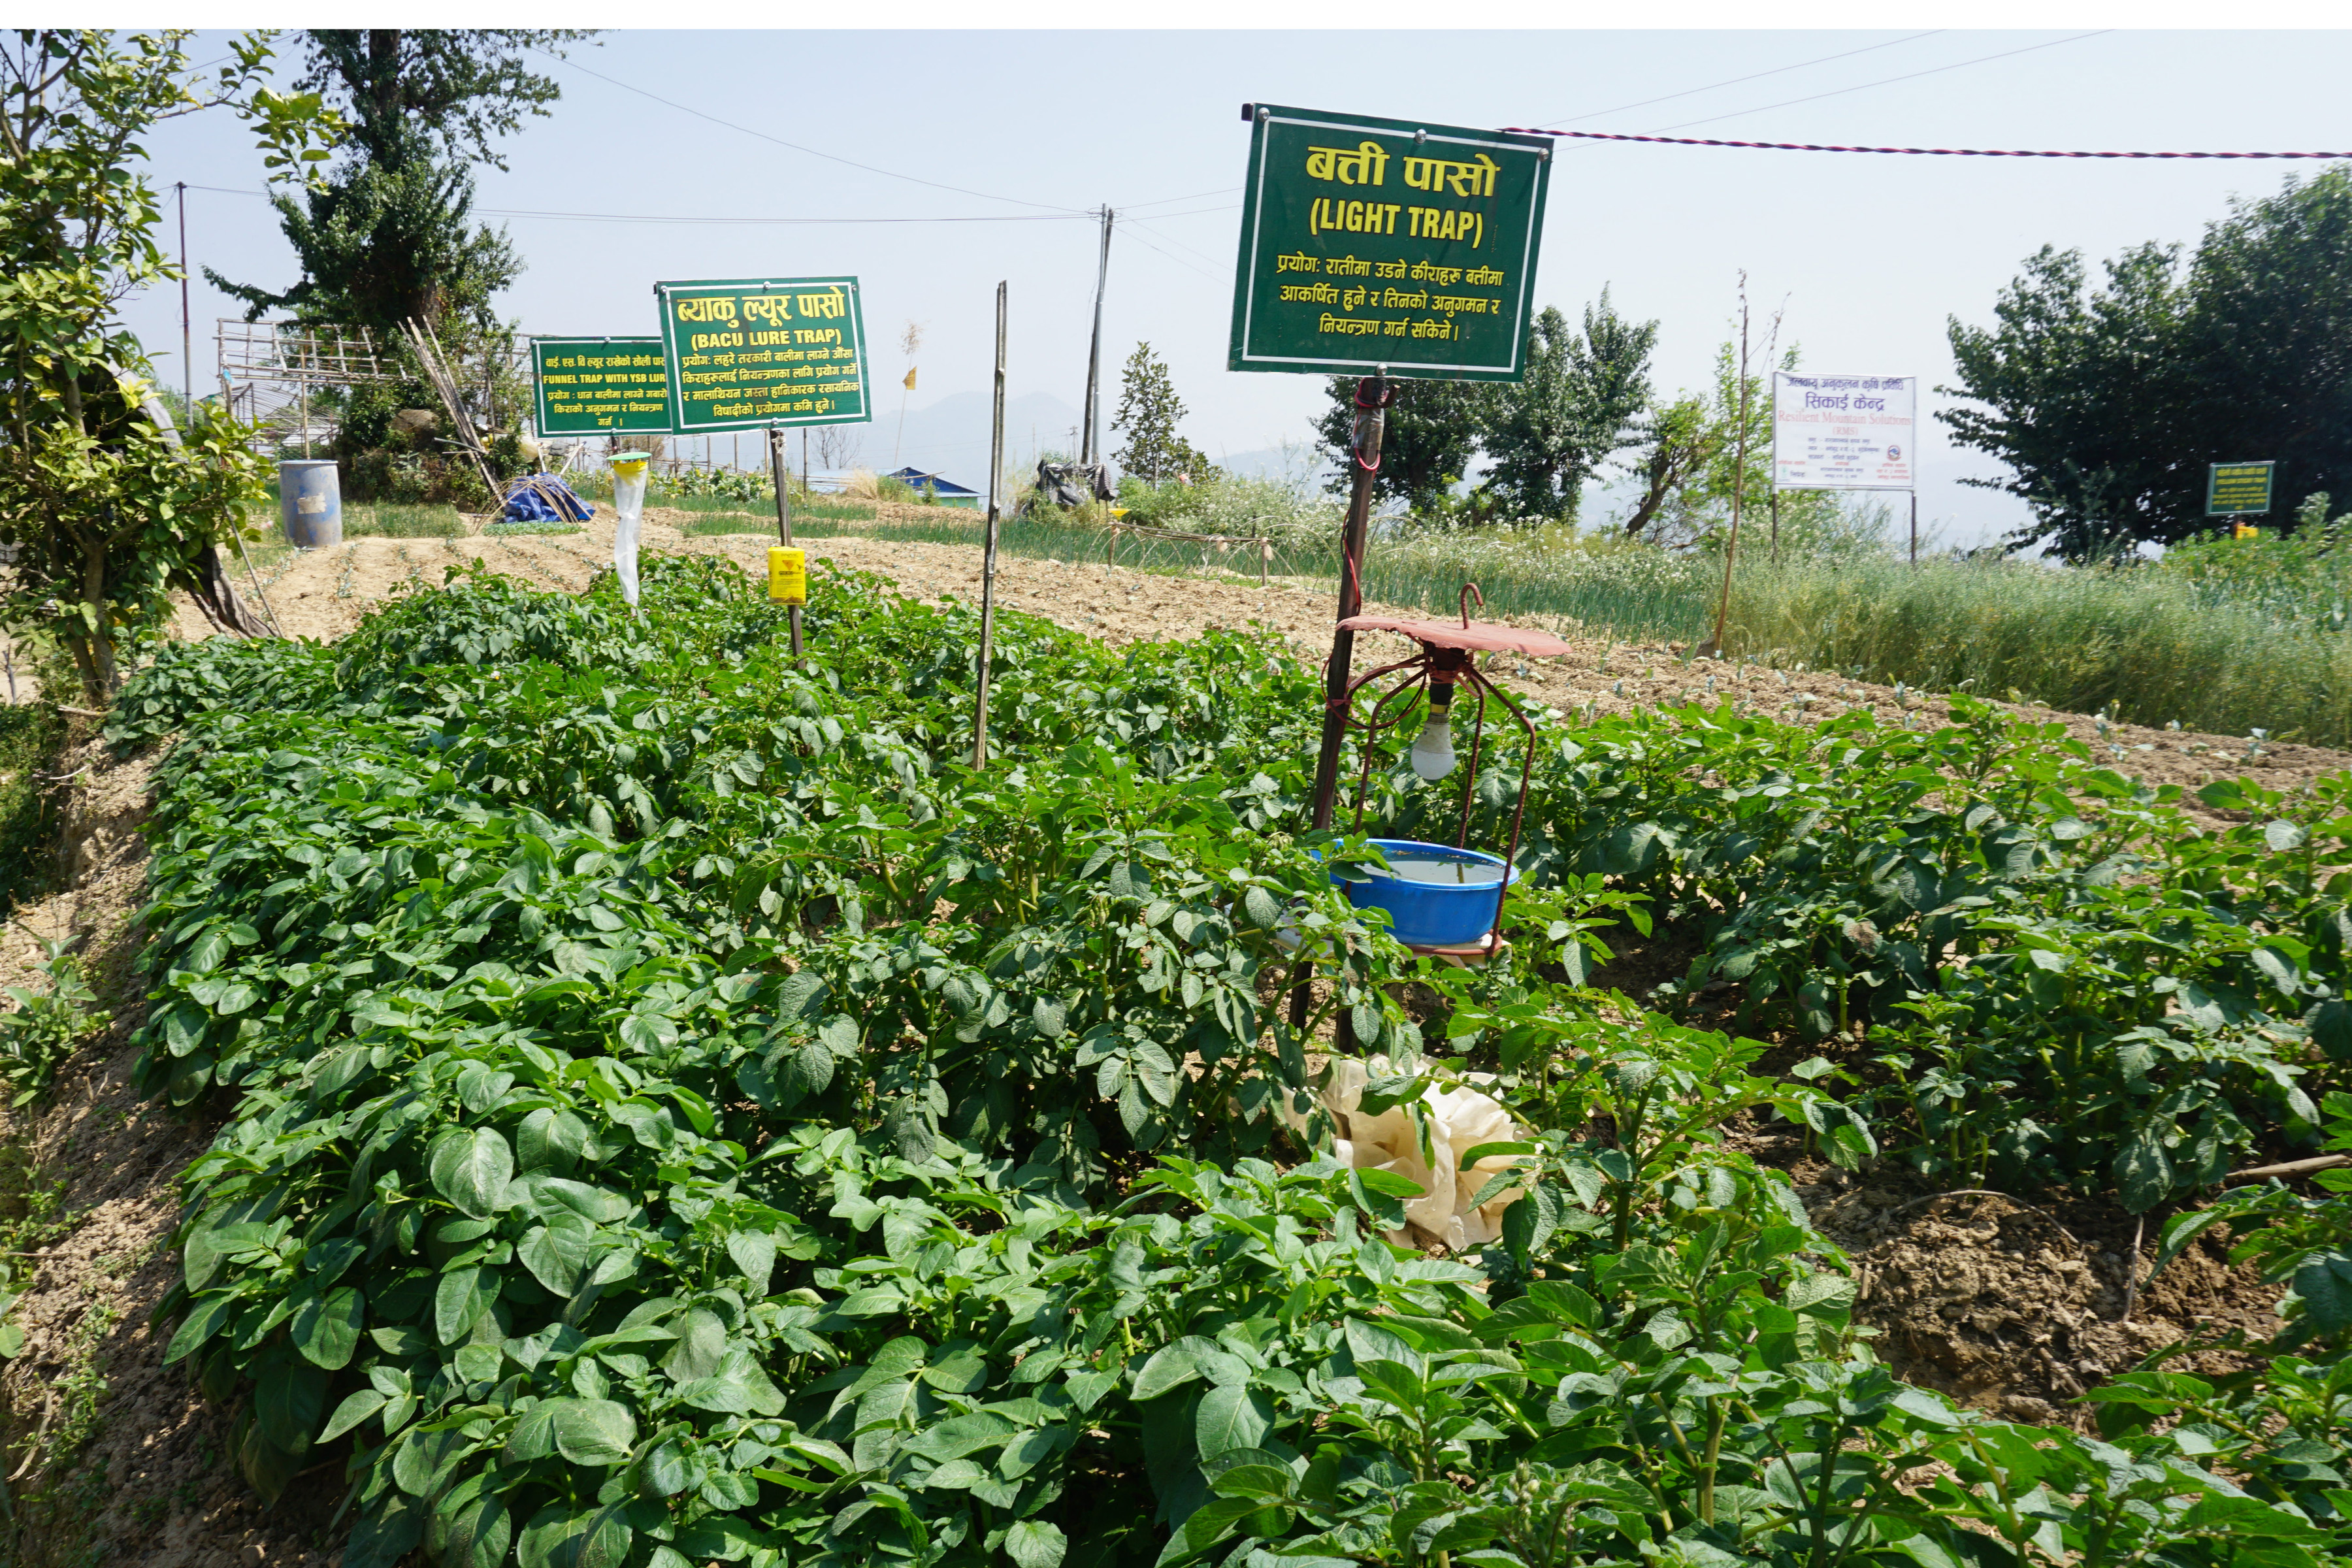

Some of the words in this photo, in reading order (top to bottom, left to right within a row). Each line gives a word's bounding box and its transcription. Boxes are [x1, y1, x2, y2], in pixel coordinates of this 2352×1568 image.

[1306, 141, 1390, 186] बत्ती
[1403, 153, 1501, 197] पासो
[1310, 197, 1400, 235] (LIGHT
[1408, 207, 1482, 248] TRAP)
[1326, 255, 1372, 276] रातीमा
[1375, 259, 1407, 279] उडने
[677, 297, 740, 328] ब्याकु
[742, 295, 792, 327] ल्यूर
[796, 286, 845, 319] पासो
[1280, 282, 1340, 304] आकर्षित
[1343, 285, 1367, 311] हुने
[1370, 291, 1380, 306] र
[1384, 287, 1428, 309] तिनको
[1431, 295, 1488, 318] अनुगमन
[1491, 300, 1501, 314] र
[1320, 312, 1380, 335] नियन्त्रण
[1384, 318, 1410, 336] गर्न
[691, 332, 743, 351] (BACU
[749, 331, 791, 346] LURE
[794, 328, 841, 345] TRAP)
[713, 351, 736, 367] लहरे
[738, 350, 772, 364] तरकारी
[806, 348, 830, 360] लाग्ने
[543, 375, 578, 384] FUNNEL
[580, 374, 603, 384] TRAP
[605, 374, 628, 383] WITH
[630, 374, 647, 383] YSB
[649, 373, 666, 382] LUR
[792, 365, 813, 378] लागि
[815, 364, 840, 378] प्रयोग
[682, 392, 690, 401] र
[743, 387, 768, 397] जस्ता
[770, 383, 816, 399] हानिकारक
[818, 380, 860, 393] रसायनिक
[554, 403, 583, 414] किराको
[585, 404, 619, 415] अनुगमन
[755, 401, 791, 416] प्रयोगमा
[793, 399, 813, 411] कमि
[1805, 391, 1849, 410] सिकाई
[1854, 394, 1885, 412] केन्द्र
[598, 416, 613, 426] गर्न
[1778, 410, 1819, 422] Resilient
[1821, 412, 1866, 424] Mountain
[1869, 413, 1911, 425] Solutions
